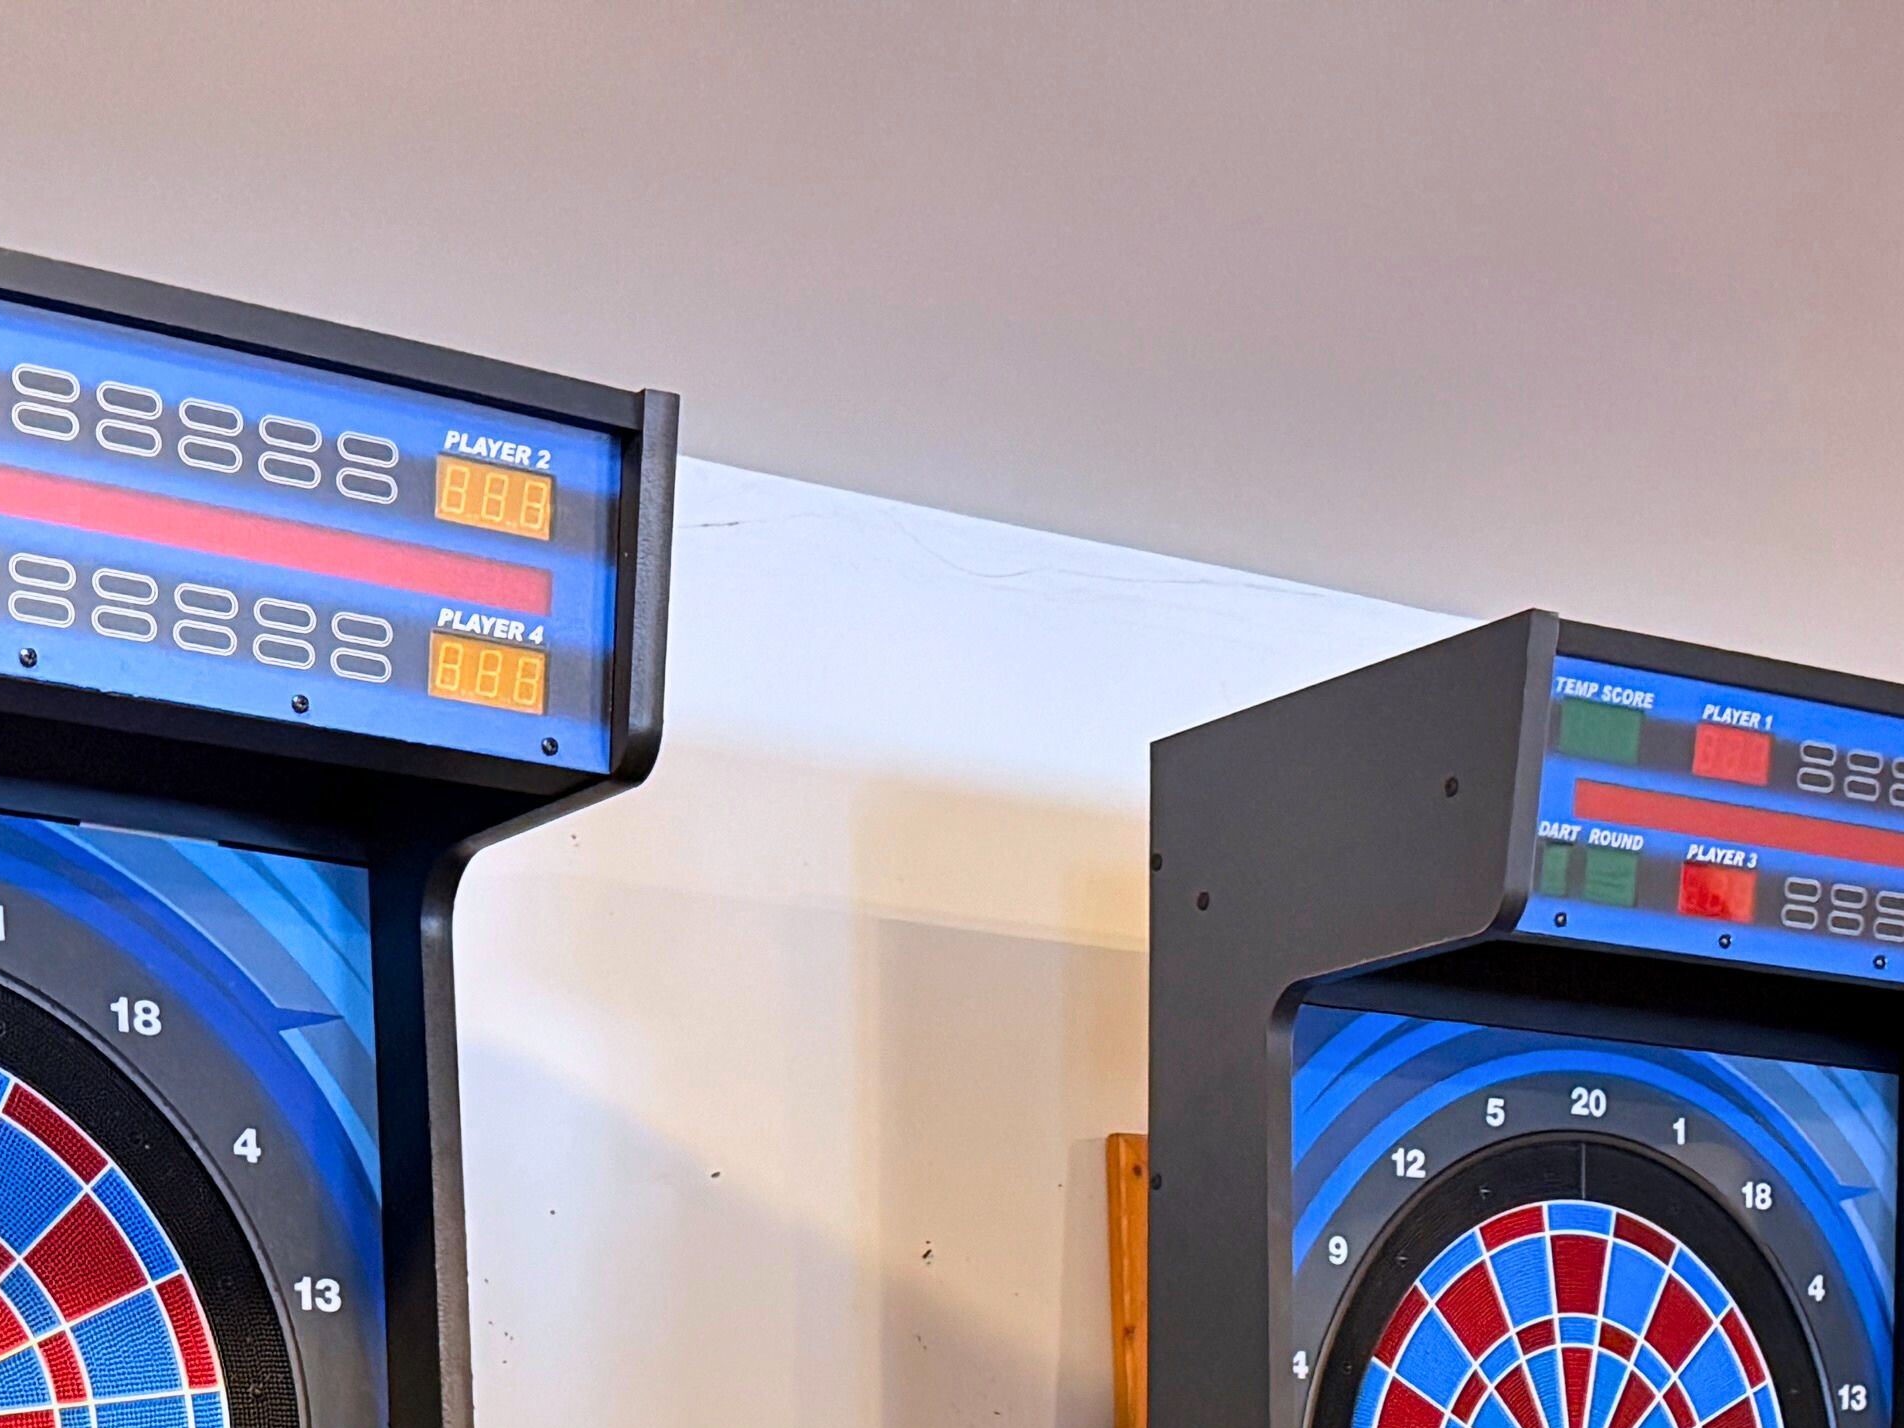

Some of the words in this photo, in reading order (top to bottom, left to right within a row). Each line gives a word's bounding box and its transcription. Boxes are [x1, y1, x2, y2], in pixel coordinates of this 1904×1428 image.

[443, 430, 531, 464] PLAYER
[534, 448, 551, 469] 2
[436, 607, 522, 641] PLAYER
[524, 624, 544, 645] 4
[1555, 675, 1598, 700] TEMP
[1601, 683, 1654, 709] SCORE
[1703, 703, 1759, 730] PLAYER
[1764, 712, 1772, 730] 1
[1539, 821, 1580, 842] DART
[1589, 828, 1644, 852] ROUND
[1687, 844, 1744, 868] PLAYER
[1744, 851, 1757, 869] 3
[110, 998, 163, 1038] 18
[1487, 1098, 1505, 1126] 5
[1571, 1089, 1607, 1118] 20
[1672, 1118, 1686, 1144] 1
[232, 1129, 261, 1164] 4
[1392, 1149, 1426, 1179] 12
[1741, 1182, 1772, 1210] 18
[1329, 1237, 1348, 1265] 9
[294, 1277, 342, 1313] 13
[1808, 1276, 1825, 1302] 4
[1838, 1384, 1867, 1412] 13
